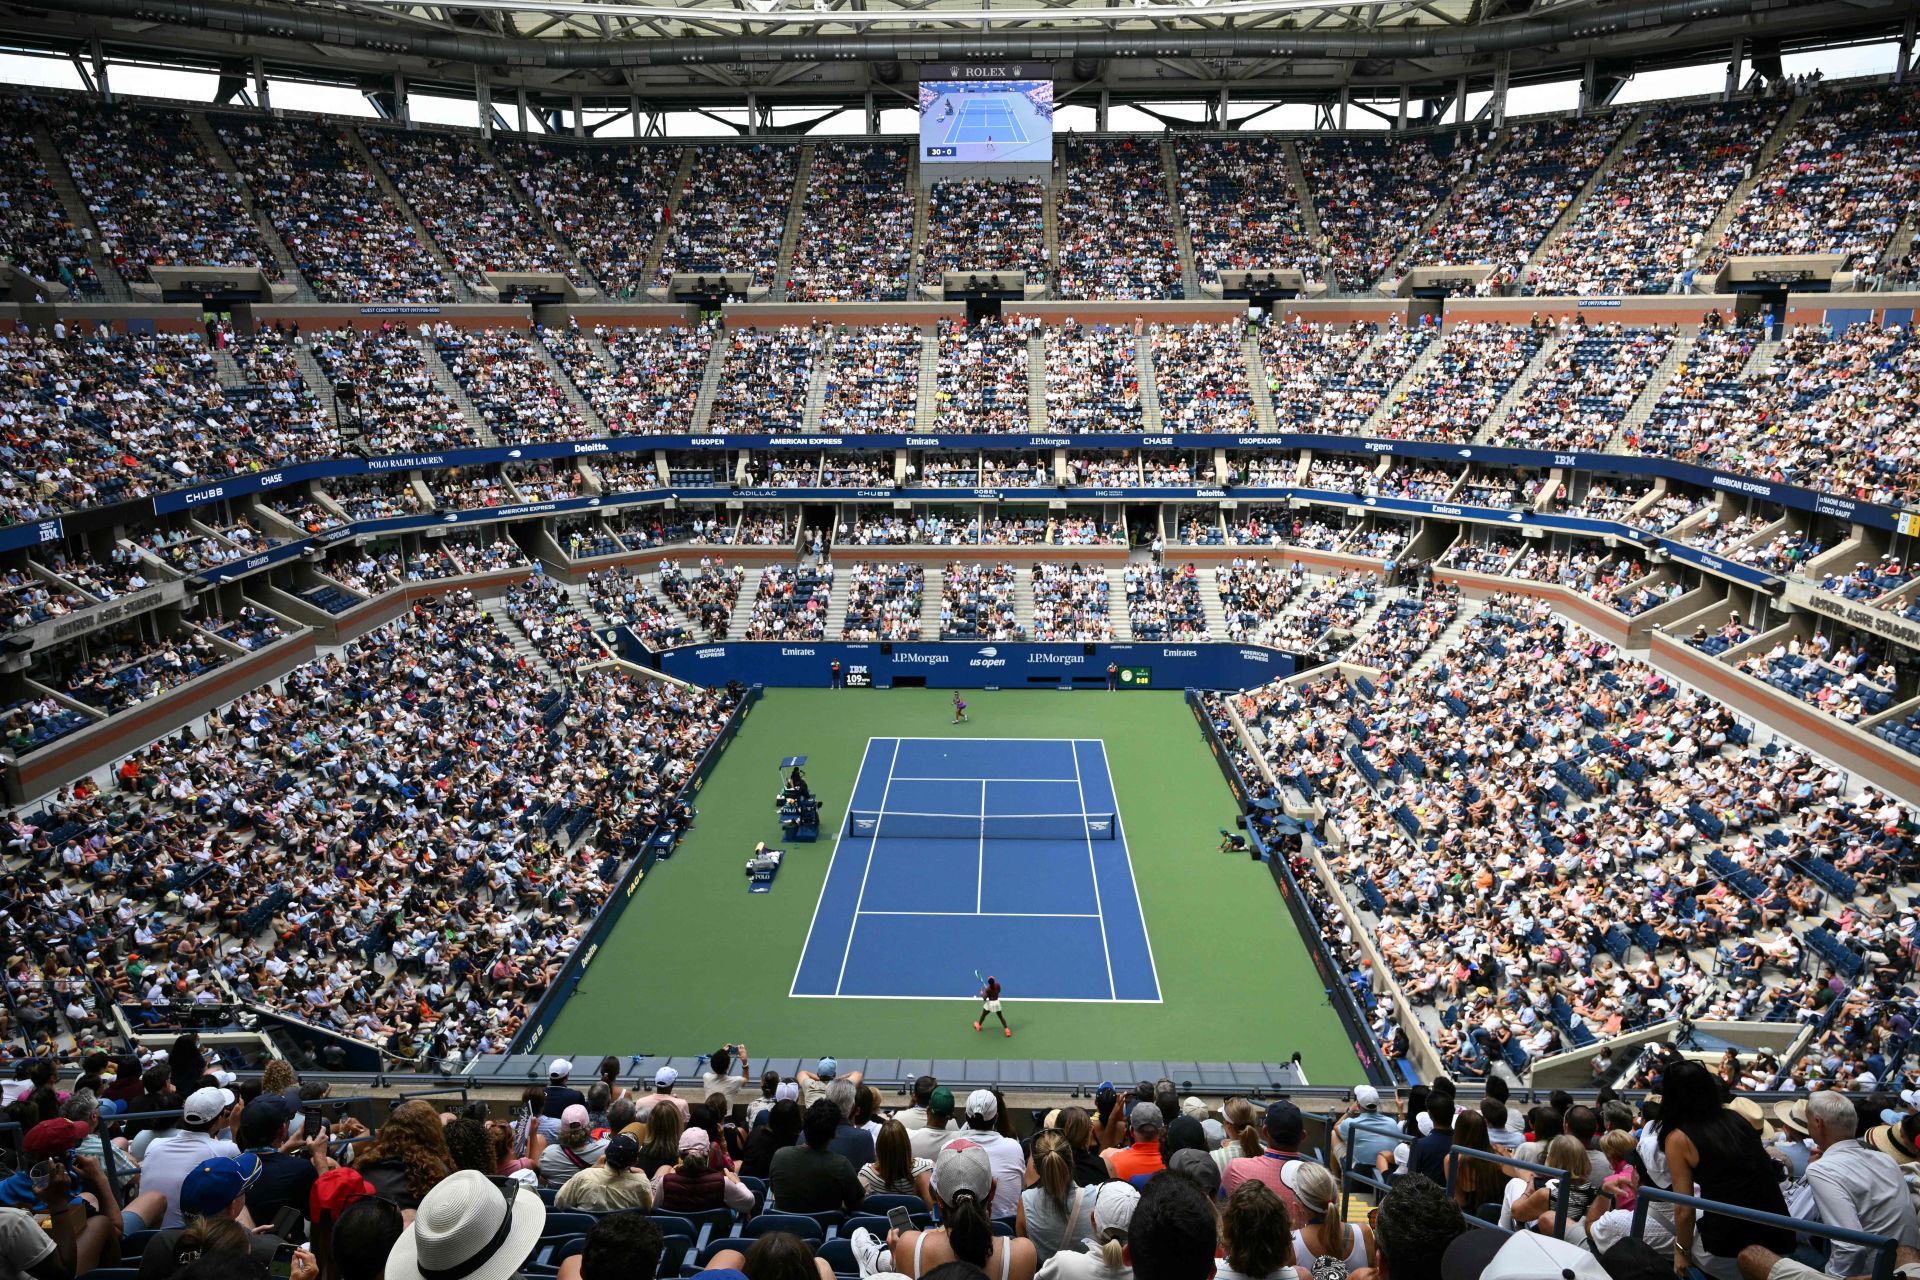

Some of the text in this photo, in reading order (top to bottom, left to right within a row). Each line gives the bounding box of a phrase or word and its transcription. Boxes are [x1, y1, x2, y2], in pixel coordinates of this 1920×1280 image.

[965, 67, 1006, 77] ROLEX
[906, 437, 939, 446] Emirates
[1365, 442, 1393, 452] argenx
[574, 444, 608, 453] Deloitte.
[390, 458, 414, 468] RALPH
[416, 456, 444, 465] LAUREN
[1555, 455, 1576, 466] IBM
[261, 474, 282, 486] CHASE
[1712, 476, 1770, 496] AMERICAN EXPRESS
[186, 488, 223, 503] CHUBB
[1823, 496, 1838, 506] NAOMI
[1839, 500, 1855, 510] OSAKA
[498, 504, 555, 516] AMERICAN EXPRESS
[1432, 505, 1461, 515] Emirates
[1822, 506, 1834, 515] COCO
[1835, 509, 1851, 518] GAUFF
[40, 528, 59, 541] IBM
[326, 528, 350, 540] SOPEN.ORG
[247, 556, 269, 568] Emirates
[1809, 594, 1845, 617] ARTHUR
[1846, 608, 1873, 628] ASHE
[892, 653, 949, 665] J.P.Morgan
[1027, 653, 1084, 665] J.P.Morgan
[1240, 649, 1268, 657] AMERICAN
[1244, 654, 1268, 662] EXPRESS
[970, 658, 1006, 668] us open
[521, 1024, 543, 1055] HUBB
